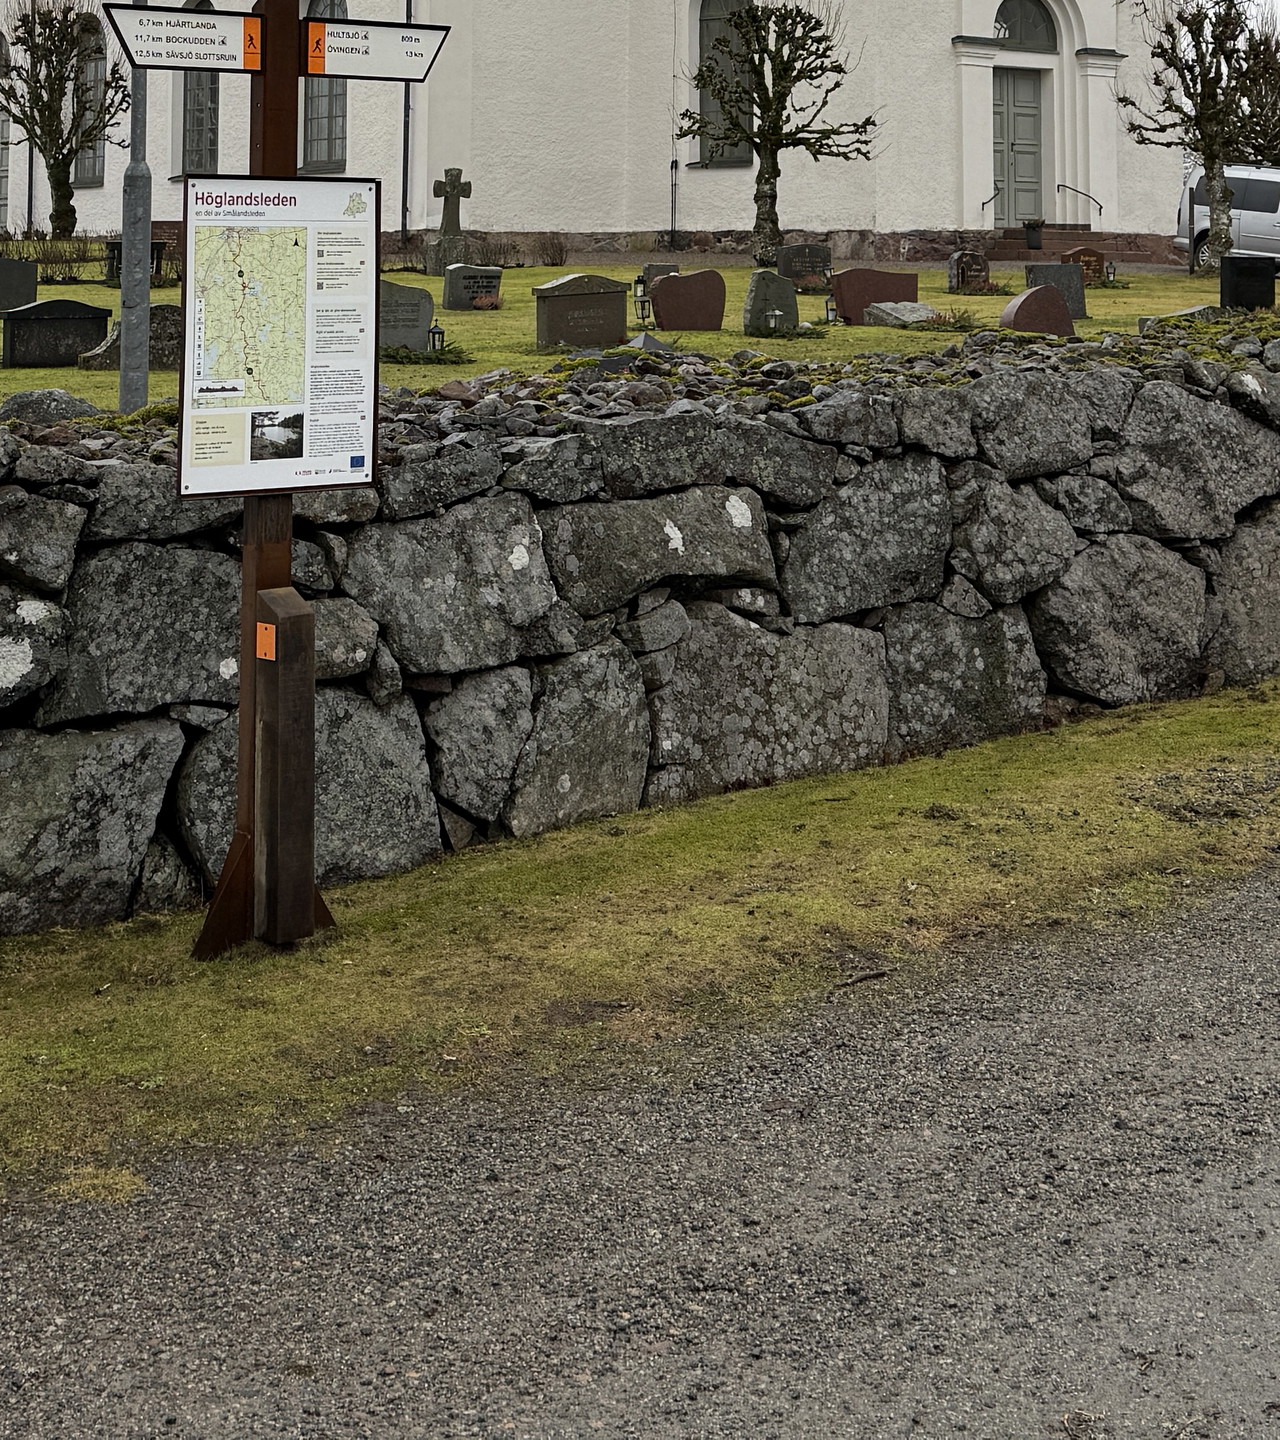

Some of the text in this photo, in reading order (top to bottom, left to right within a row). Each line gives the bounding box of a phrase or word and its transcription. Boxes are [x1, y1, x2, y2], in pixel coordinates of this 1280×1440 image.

[139, 19, 217, 30] 6,7 km HJÄRTLANDA
[135, 35, 215, 46] 11,7 km BOCKUDDEN
[327, 45, 361, 54] ÖVINGEN
[135, 50, 237, 62] 12,5 km SÄVSJÖ SLOTTSRUIN
[195, 191, 297, 208] Höglandsleden
[223, 209, 266, 217] Smålandsleden
